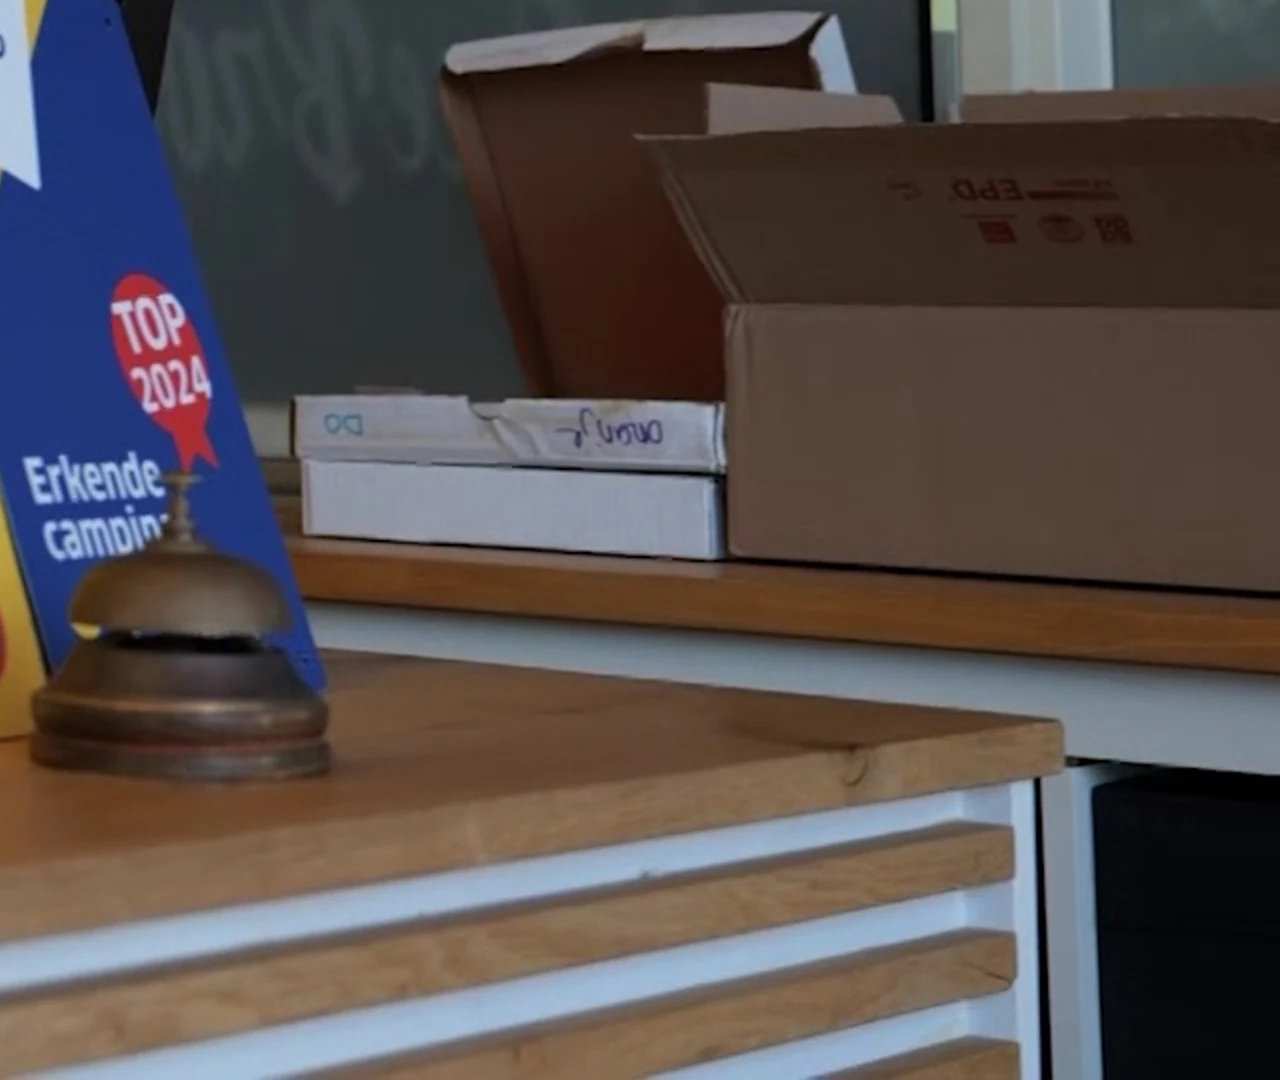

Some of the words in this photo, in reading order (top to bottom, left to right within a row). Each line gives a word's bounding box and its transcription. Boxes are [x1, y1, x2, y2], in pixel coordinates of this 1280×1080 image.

[110, 292, 186, 355] TOP
[130, 353, 213, 415] 2024
[22, 450, 167, 506] Erkende
[42, 503, 170, 562] campin
